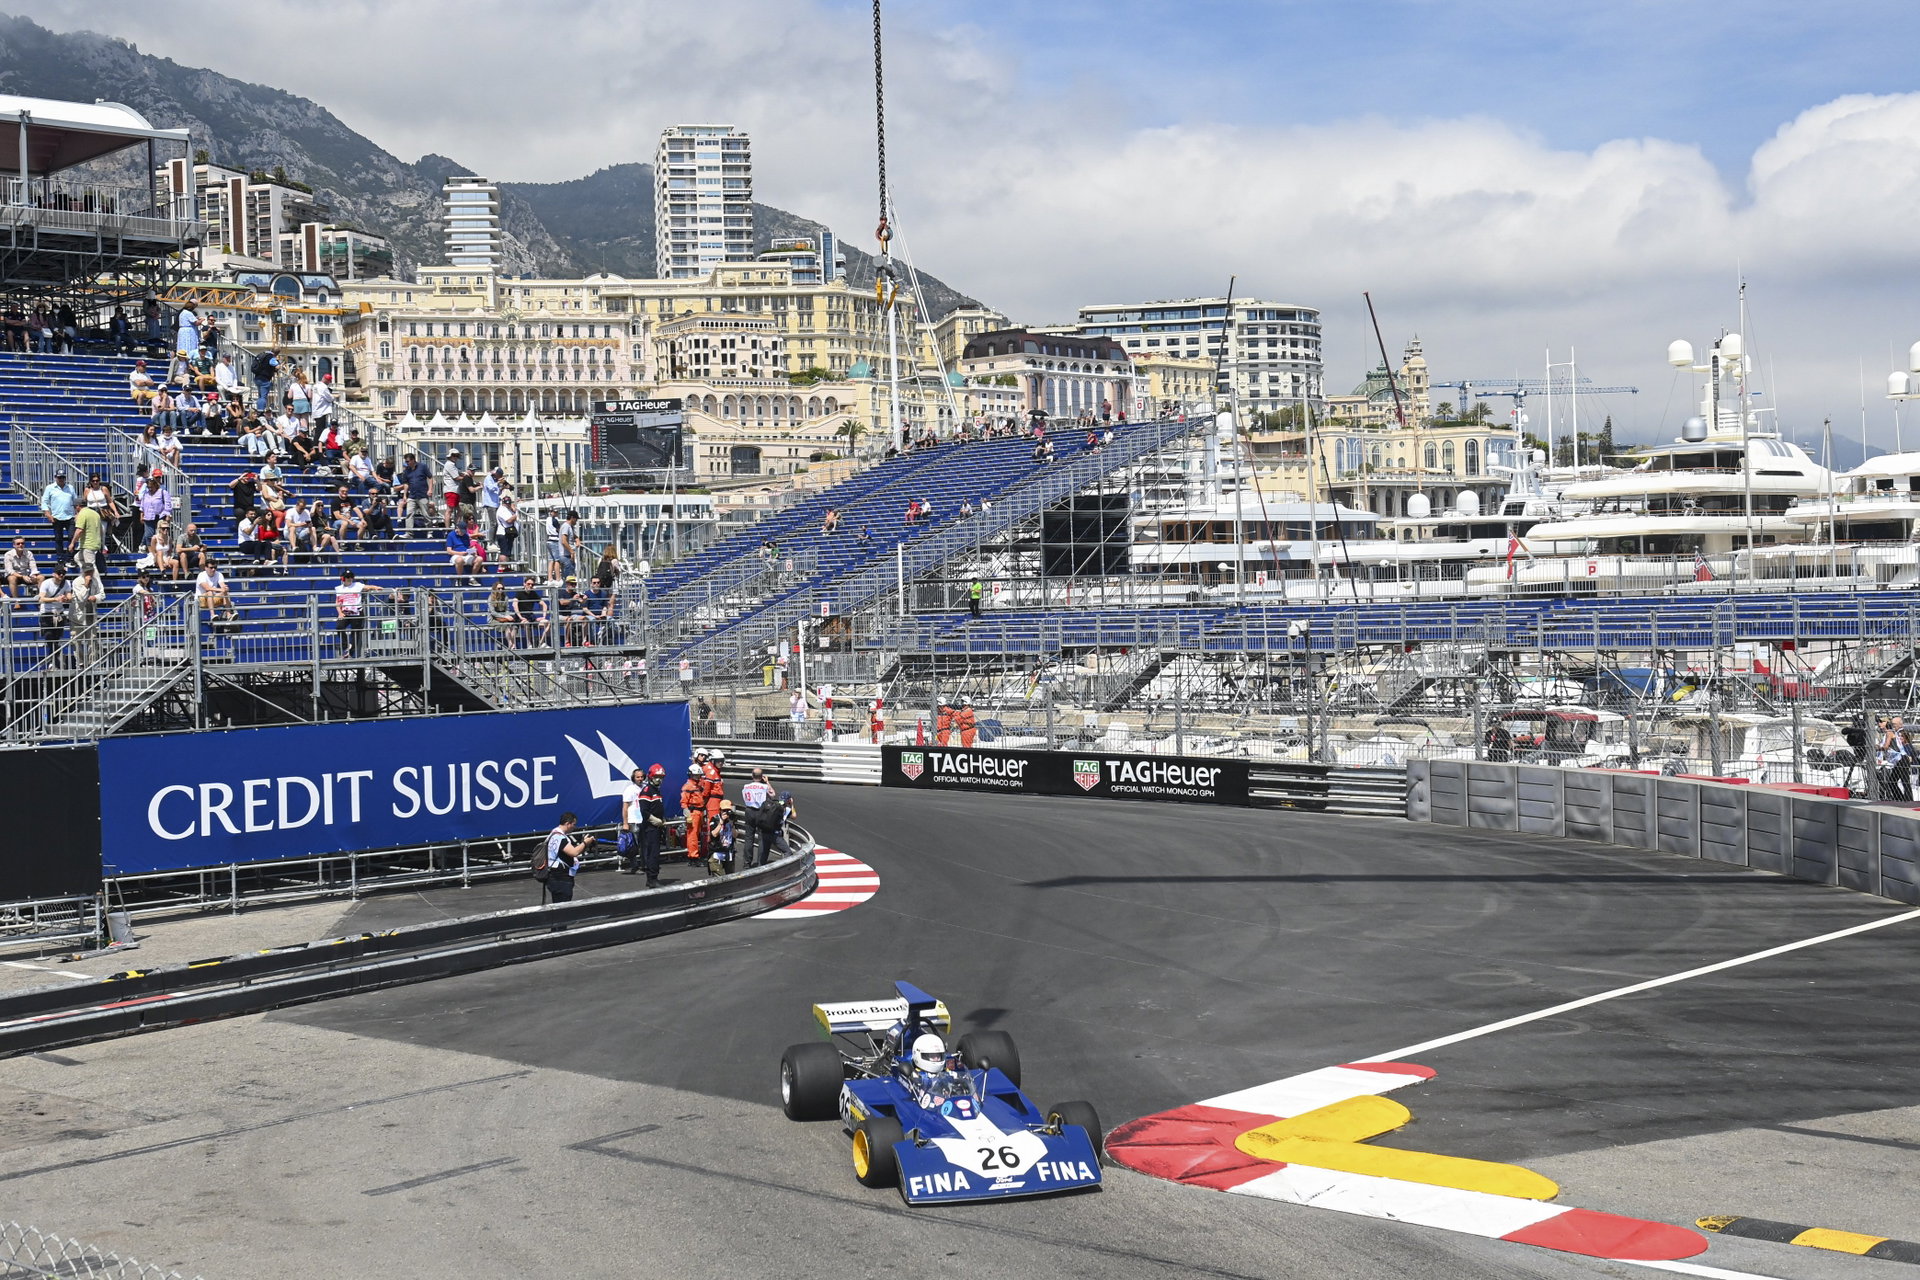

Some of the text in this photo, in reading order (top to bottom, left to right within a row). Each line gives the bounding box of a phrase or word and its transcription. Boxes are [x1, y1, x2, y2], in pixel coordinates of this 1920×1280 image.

[903, 753, 922, 764] TAG
[902, 764, 923, 777] HEUER
[1075, 762, 1098, 773] TAG
[933, 775, 1024, 788] OFFICIAL WATCH MONACO GPH
[1074, 773, 1100, 788] HEUER
[148, 755, 559, 841] CREDIT SUISSE
[1111, 785, 1215, 797] OFFICIAL WATCH MONACO GPH
[976, 1145, 1021, 1171] 26
[1036, 1161, 1096, 1182] FINA
[909, 1170, 971, 1197] FINA
